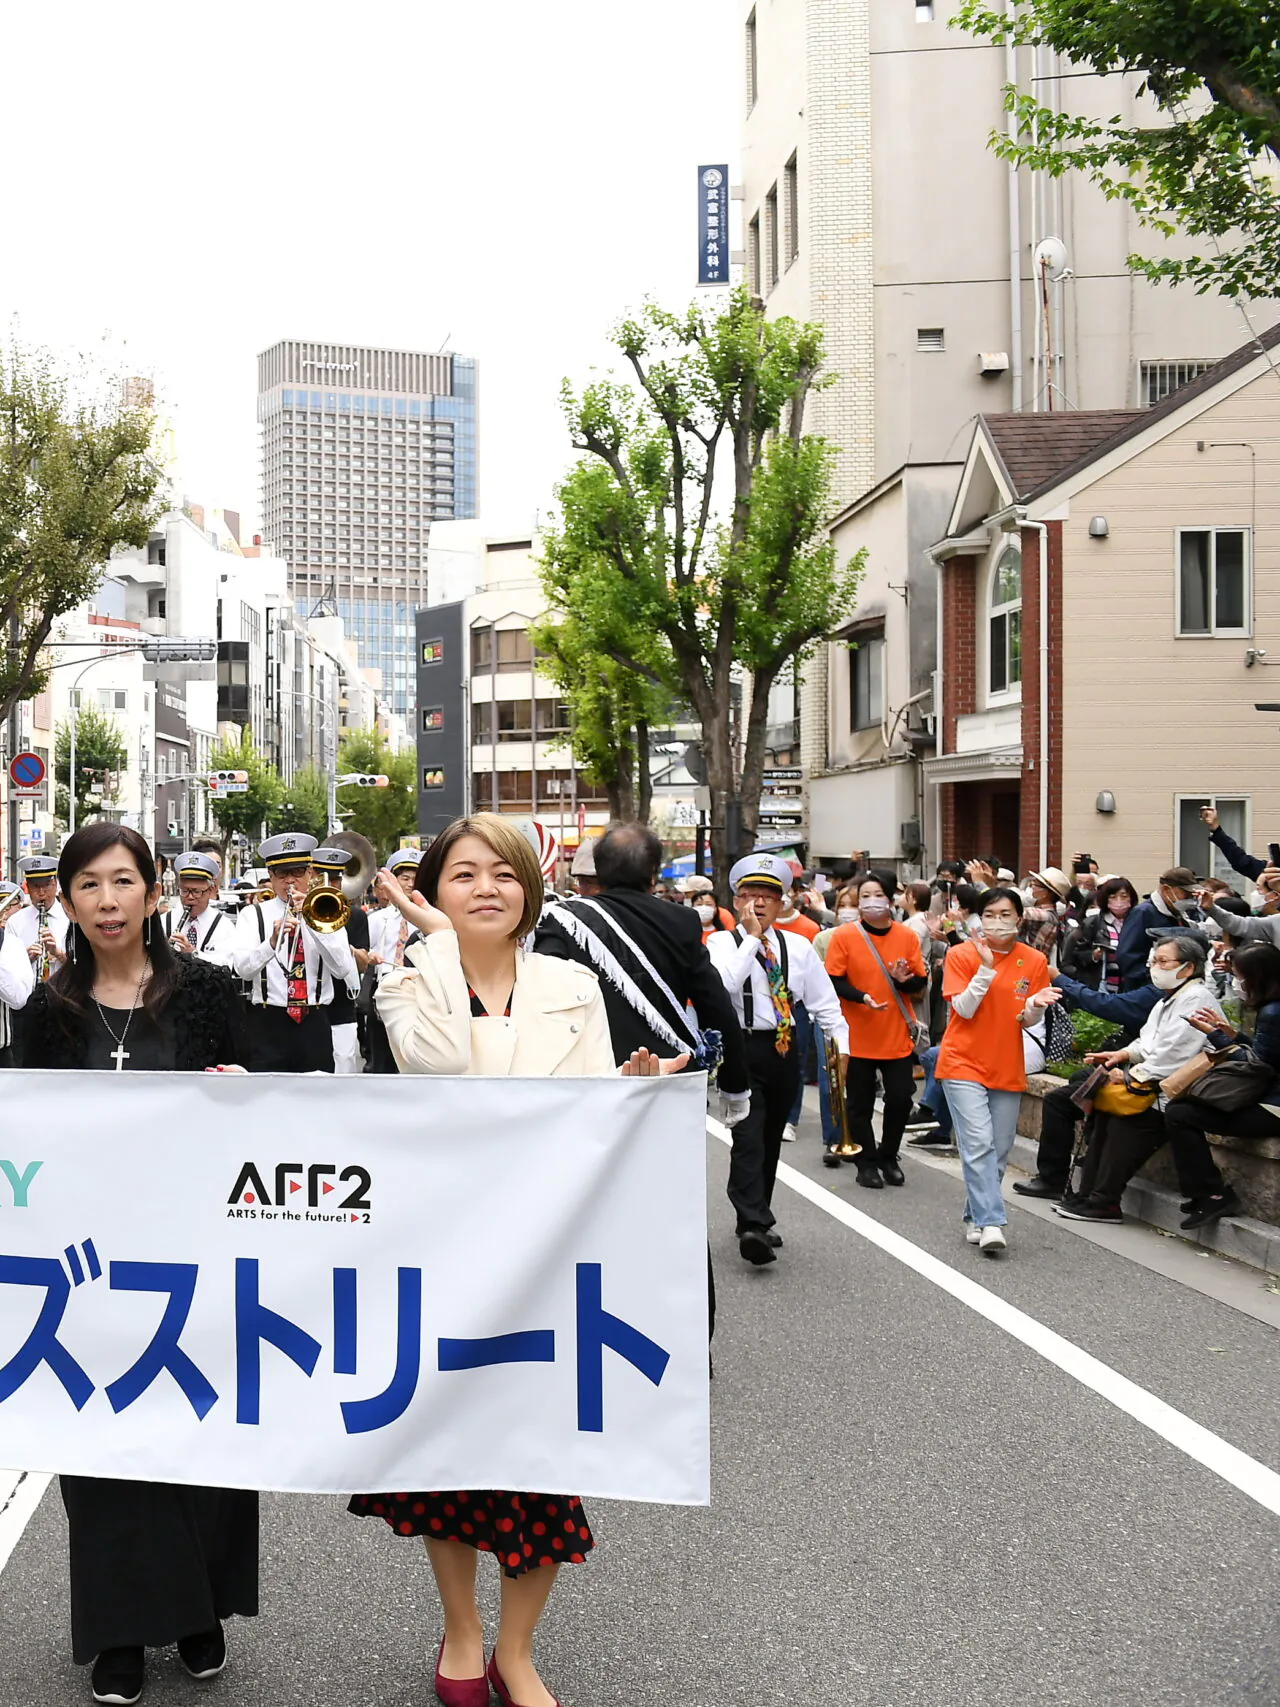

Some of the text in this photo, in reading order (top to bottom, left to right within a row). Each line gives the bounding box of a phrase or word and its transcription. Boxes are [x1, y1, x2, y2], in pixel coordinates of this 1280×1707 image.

[227, 1162, 372, 1210] AFF2
[227, 1209, 257, 1219] ARTS
[260, 1209, 279, 1220] for
[282, 1210, 301, 1221] the
[305, 1211, 347, 1223] future!
